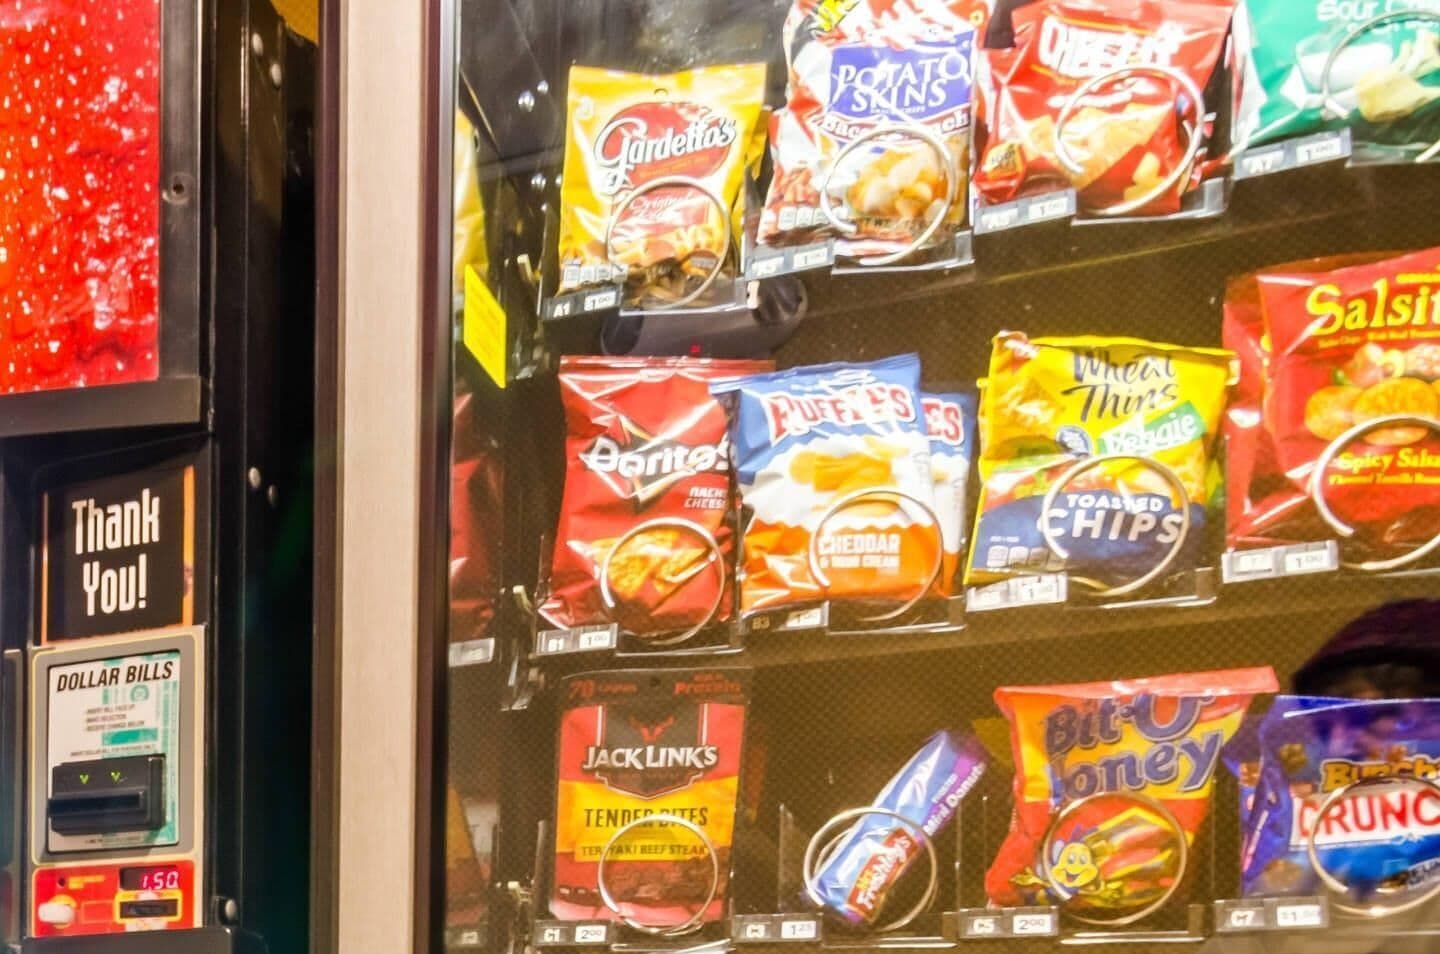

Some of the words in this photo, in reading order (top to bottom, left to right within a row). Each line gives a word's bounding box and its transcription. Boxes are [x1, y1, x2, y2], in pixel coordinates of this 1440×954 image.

[851, 77, 949, 113] SKINS
[594, 118, 737, 188] Gardetto's
[554, 301, 570, 318] A1
[1074, 349, 1178, 384] Wheat
[1062, 384, 1178, 422] Thins
[578, 433, 729, 479] Doritos
[683, 496, 727, 510] CHEES
[688, 486, 727, 499] NACH
[1066, 493, 1165, 515] TOASTED
[71, 487, 160, 556] Thank
[1037, 508, 1184, 544] CHIPS
[818, 533, 901, 556] CHEDDAR
[82, 553, 148, 617] You!
[56, 666, 121, 694] DOLLAR
[125, 660, 174, 684] BILLS
[582, 746, 644, 770] JACK
[645, 744, 718, 769] LINK'S
[1052, 733, 1225, 798] oney
[584, 809, 656, 829] TENDER
[658, 806, 710, 829] BITES
